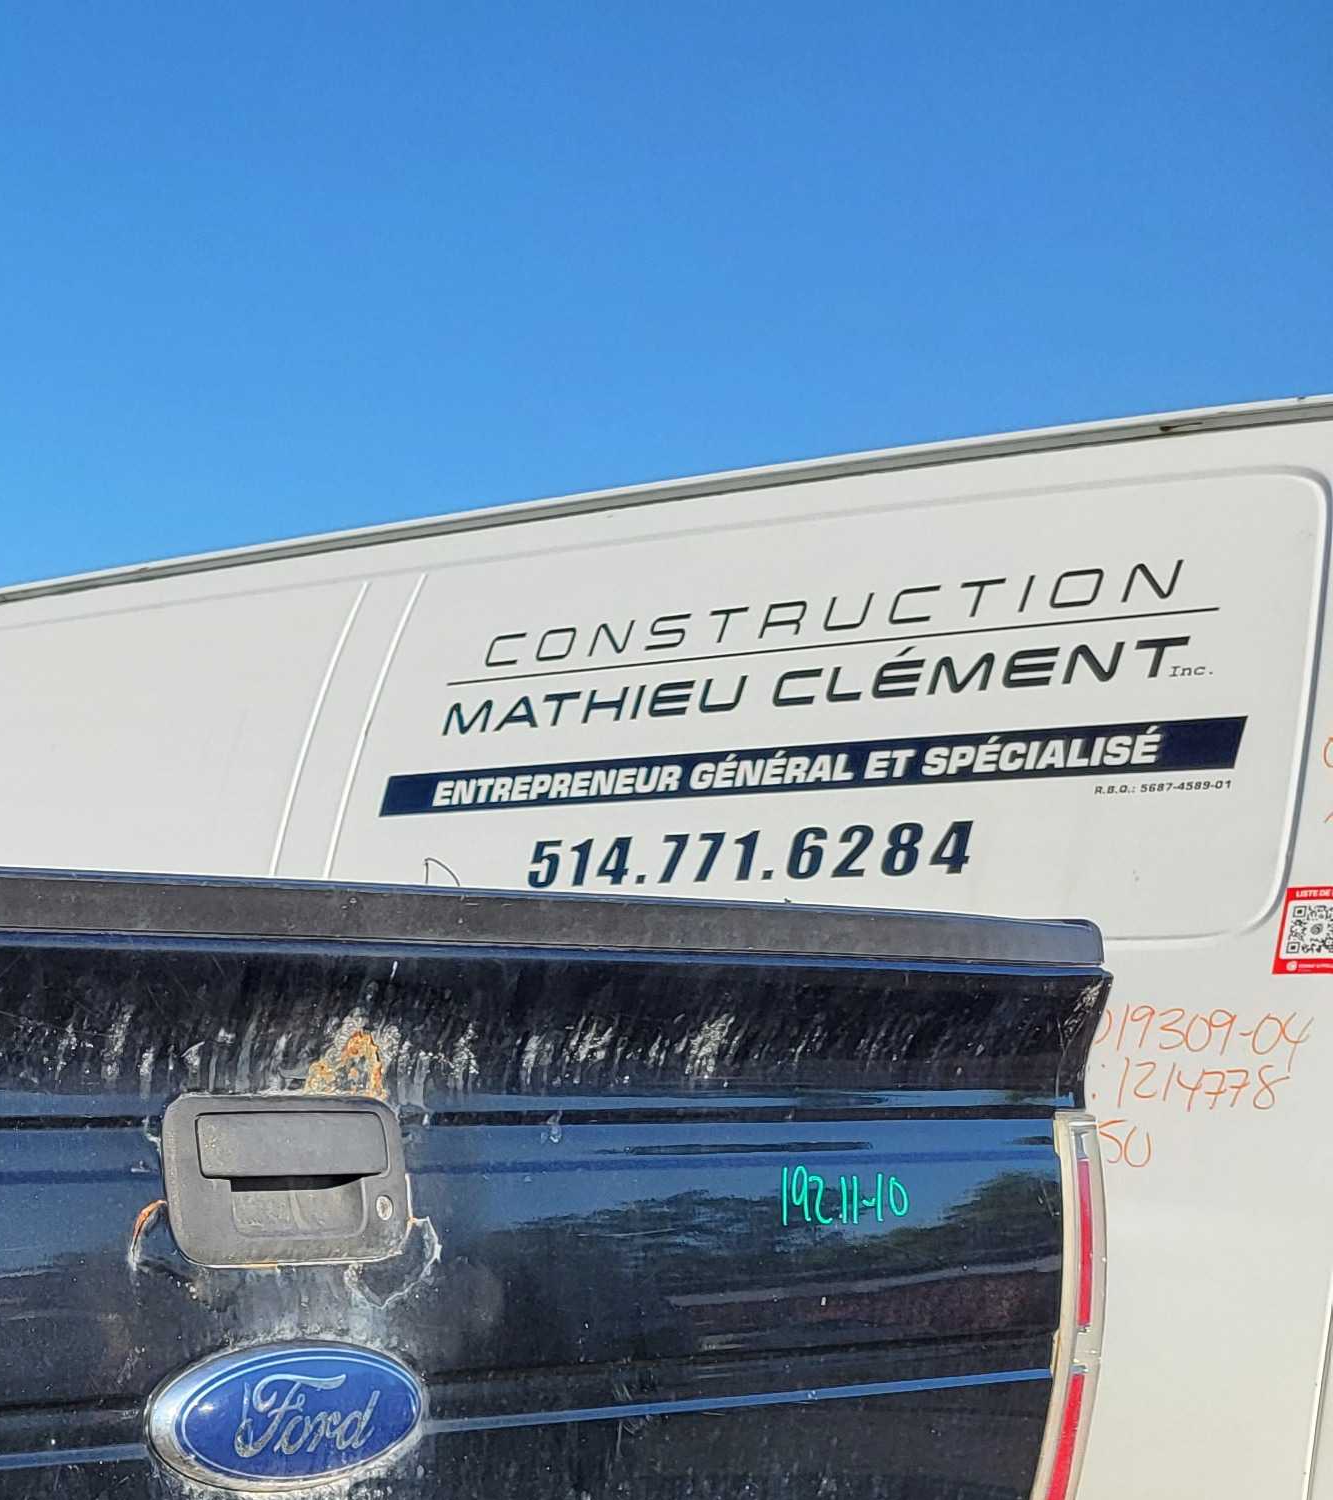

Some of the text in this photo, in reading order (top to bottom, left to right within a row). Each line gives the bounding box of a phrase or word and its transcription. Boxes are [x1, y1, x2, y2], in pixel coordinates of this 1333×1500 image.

[484, 558, 1184, 669] CONSTRUCTION
[441, 634, 1214, 737] MATHIEU CLÉMENT Inc.
[432, 725, 1163, 808] ENTREPRENEUR GÉNÉRAL ET SPÉCIALISÉ
[1140, 779, 1232, 794] 5687-4589-01
[527, 820, 974, 889] 514.771.6284
[235, 1373, 381, 1459] Ford
